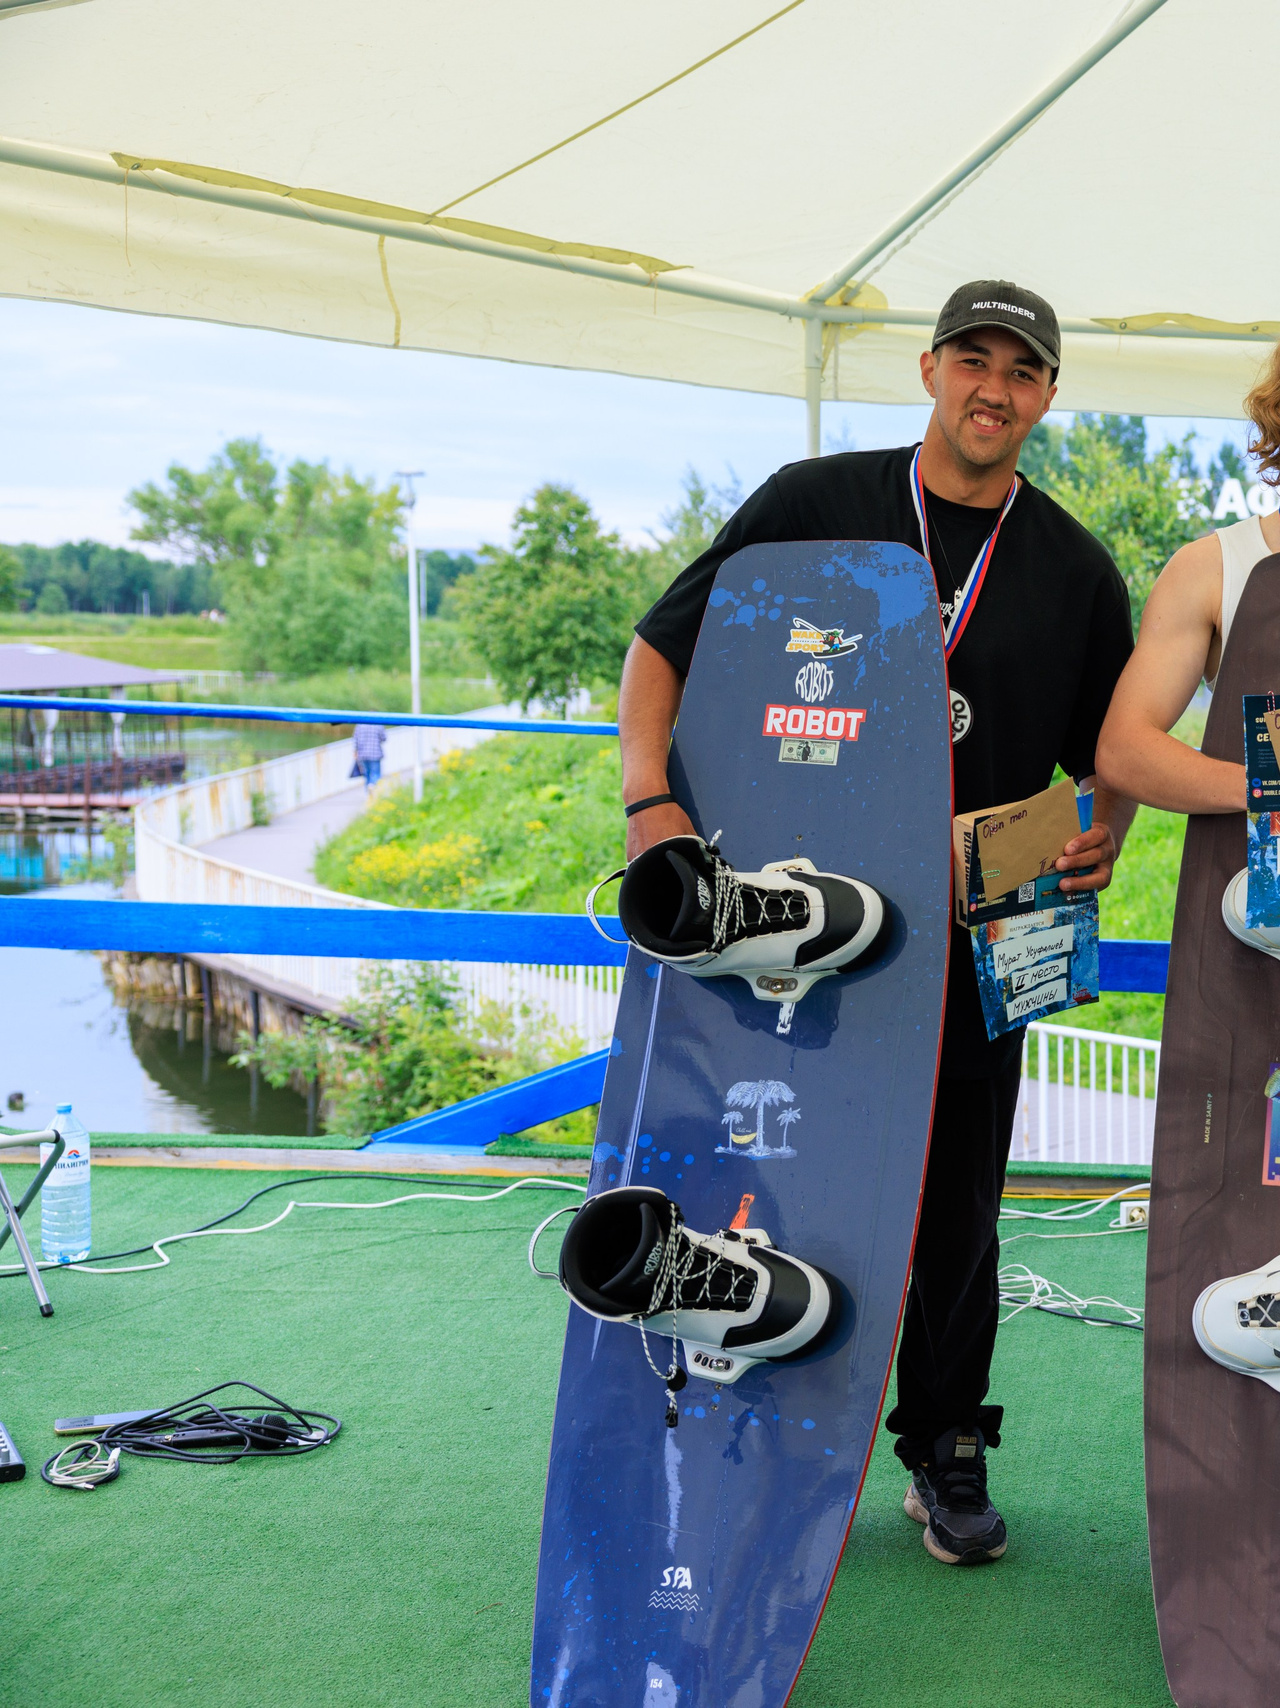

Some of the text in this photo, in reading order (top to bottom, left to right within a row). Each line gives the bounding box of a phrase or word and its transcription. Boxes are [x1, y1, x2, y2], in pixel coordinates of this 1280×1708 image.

[971, 301, 1036, 321] MULTIRIDERS
[787, 642, 825, 652] SPORT
[795, 661, 834, 703] ROBOT
[766, 707, 864, 738] ROBOT
[951, 699, 968, 738] СТО
[982, 808, 1028, 839] Open men
[997, 952, 1022, 973] Мурат
[660, 1566, 692, 1590] SPA
[650, 1678, 663, 1689] 154
